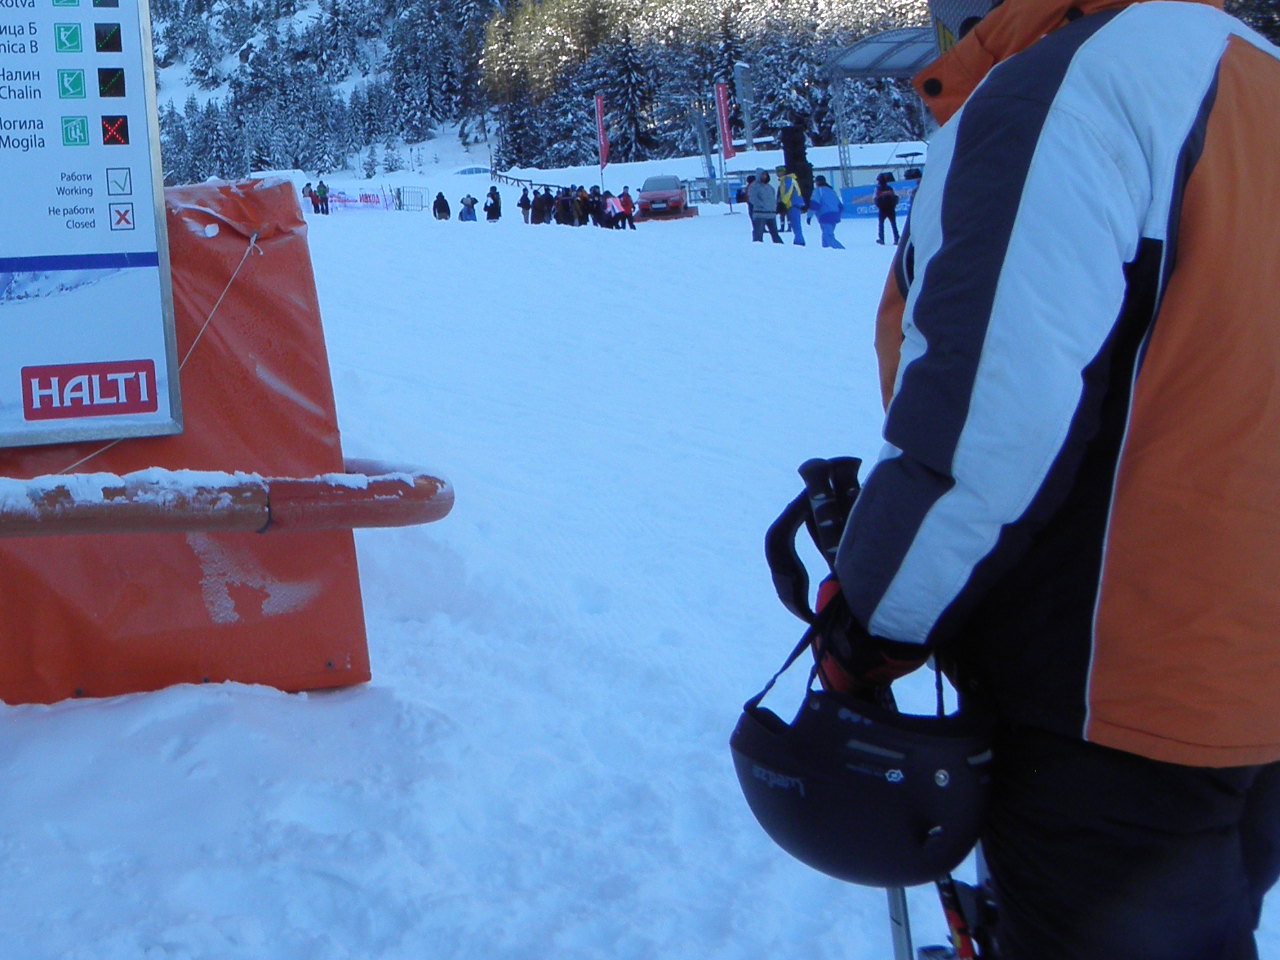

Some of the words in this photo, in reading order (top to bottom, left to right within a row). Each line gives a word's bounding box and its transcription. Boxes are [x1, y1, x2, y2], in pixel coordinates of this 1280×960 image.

[29, 23, 37, 35] Б
[31, 41, 38, 53] B
[31, 371, 149, 409] HALTI
